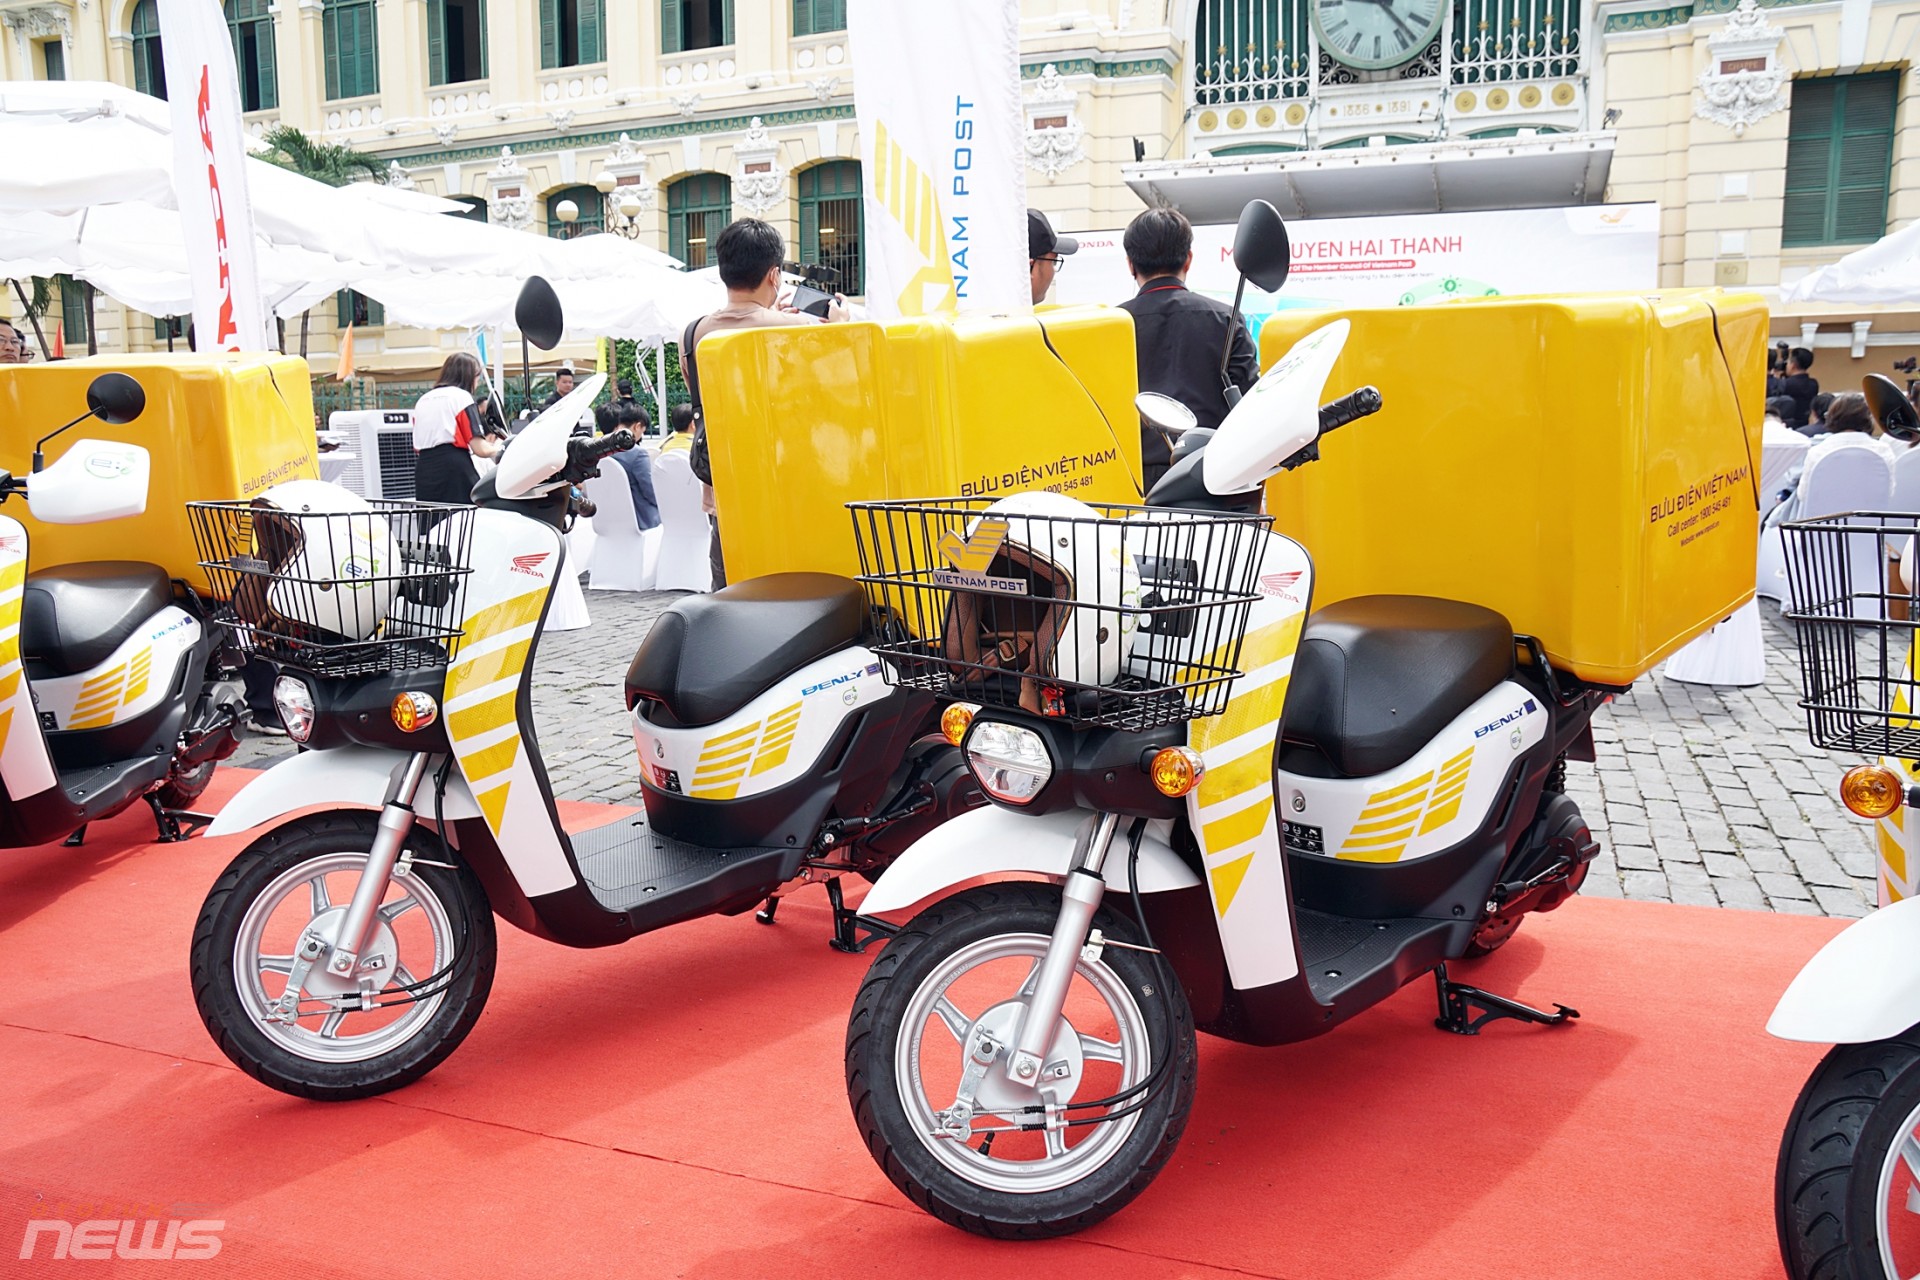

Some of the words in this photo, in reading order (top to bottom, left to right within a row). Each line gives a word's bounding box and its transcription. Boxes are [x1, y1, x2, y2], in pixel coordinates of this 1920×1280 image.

[1387, 100, 1411, 113] 1891
[953, 95, 974, 196] POST
[1077, 240, 1115, 249] ONDA
[1349, 239, 1383, 257] HAI
[1389, 236, 1462, 256] THANH
[951, 217, 969, 298] NAM
[293, 454, 309, 469] NAM
[961, 475, 998, 497] BƯU
[1001, 465, 1043, 488] ĐIỆN
[1045, 456, 1079, 478] VIỆT
[1082, 448, 1117, 469] NAM
[1063, 479, 1078, 492] 545
[1079, 475, 1094, 487] 481
[1650, 497, 1675, 523] BƯU
[1676, 484, 1702, 511] ĐIỆN
[1703, 474, 1724, 499] VIỆT
[1725, 465, 1748, 487] NAM
[1667, 521, 1680, 537] Call
[510, 566, 545, 579] HONDA
[934, 573, 988, 589] VIETNAM
[990, 580, 1025, 592] POST
[1258, 586, 1301, 604] HONDA
[801, 669, 864, 697] BENLY
[1474, 706, 1524, 739] BENLY
